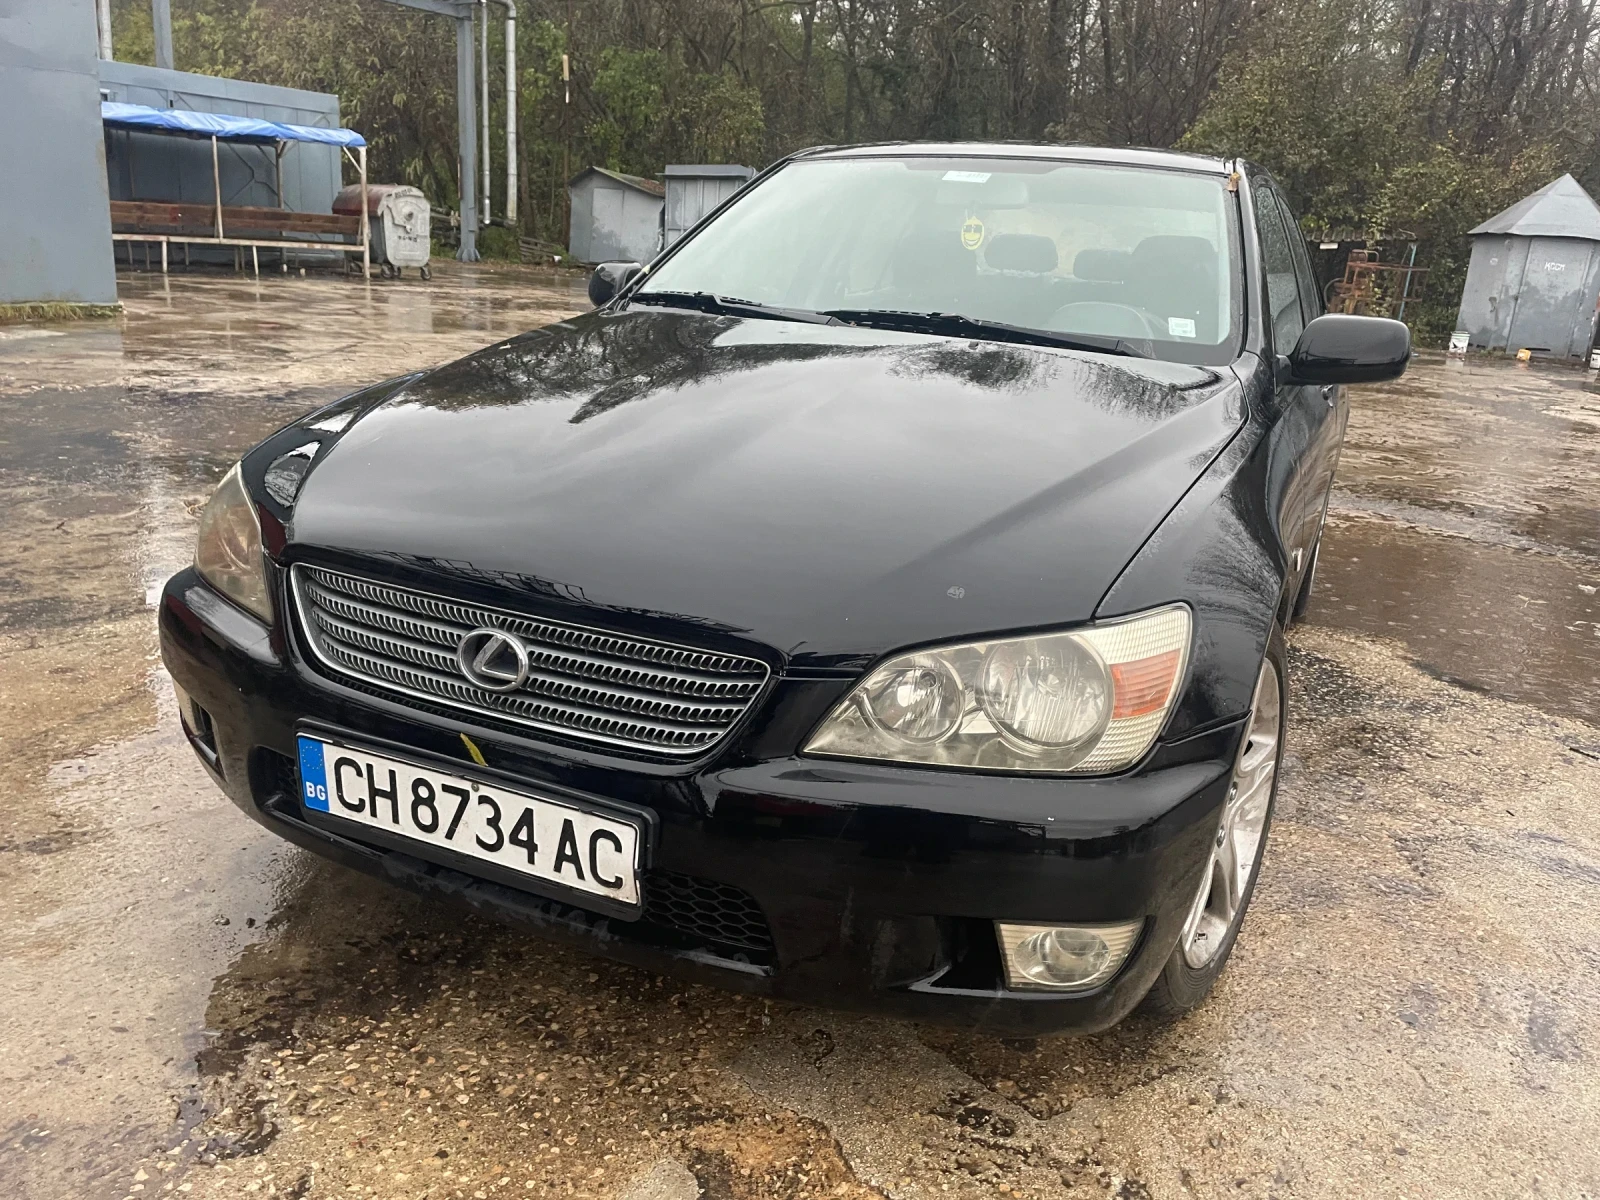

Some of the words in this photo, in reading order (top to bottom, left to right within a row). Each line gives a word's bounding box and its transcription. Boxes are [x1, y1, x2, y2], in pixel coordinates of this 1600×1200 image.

[305, 781, 326, 801] BG
[334, 757, 400, 825] CH
[410, 777, 538, 865] 8734
[553, 818, 623, 889] AC
